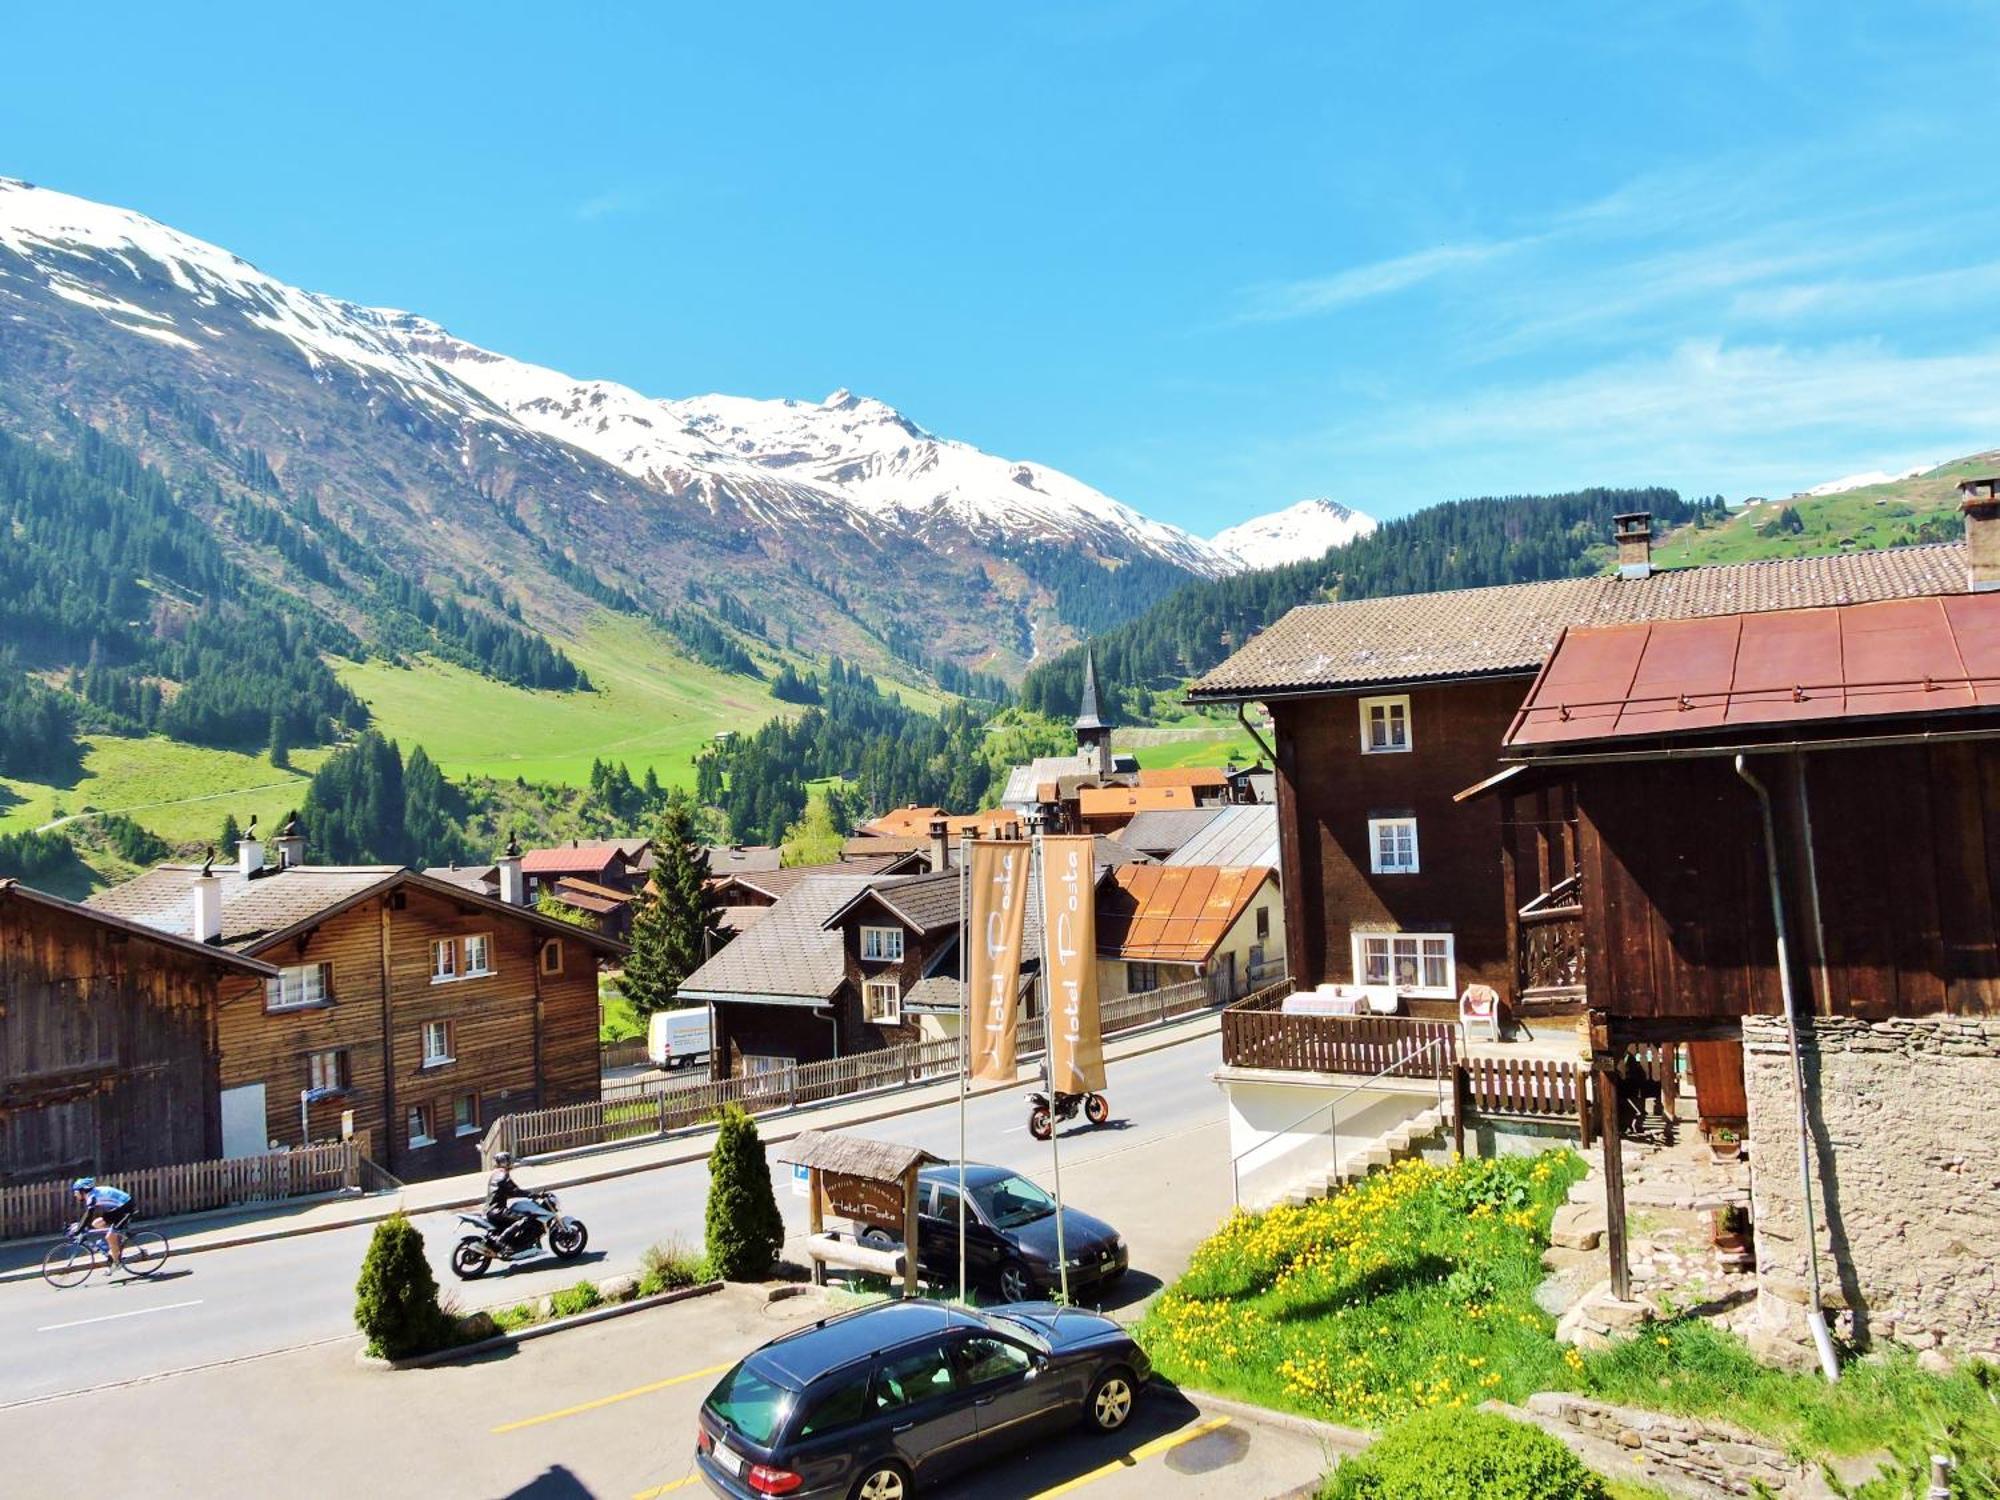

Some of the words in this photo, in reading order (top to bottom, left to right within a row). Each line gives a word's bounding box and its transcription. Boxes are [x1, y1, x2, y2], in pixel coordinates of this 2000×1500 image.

[987, 854, 1014, 961] Posta
[1058, 851, 1078, 966] Posta
[981, 974, 1005, 1070] Hotel
[1064, 980, 1085, 1084] Hotel
[828, 1197, 861, 1214] Hotel
[862, 1203, 896, 1221] Posta
